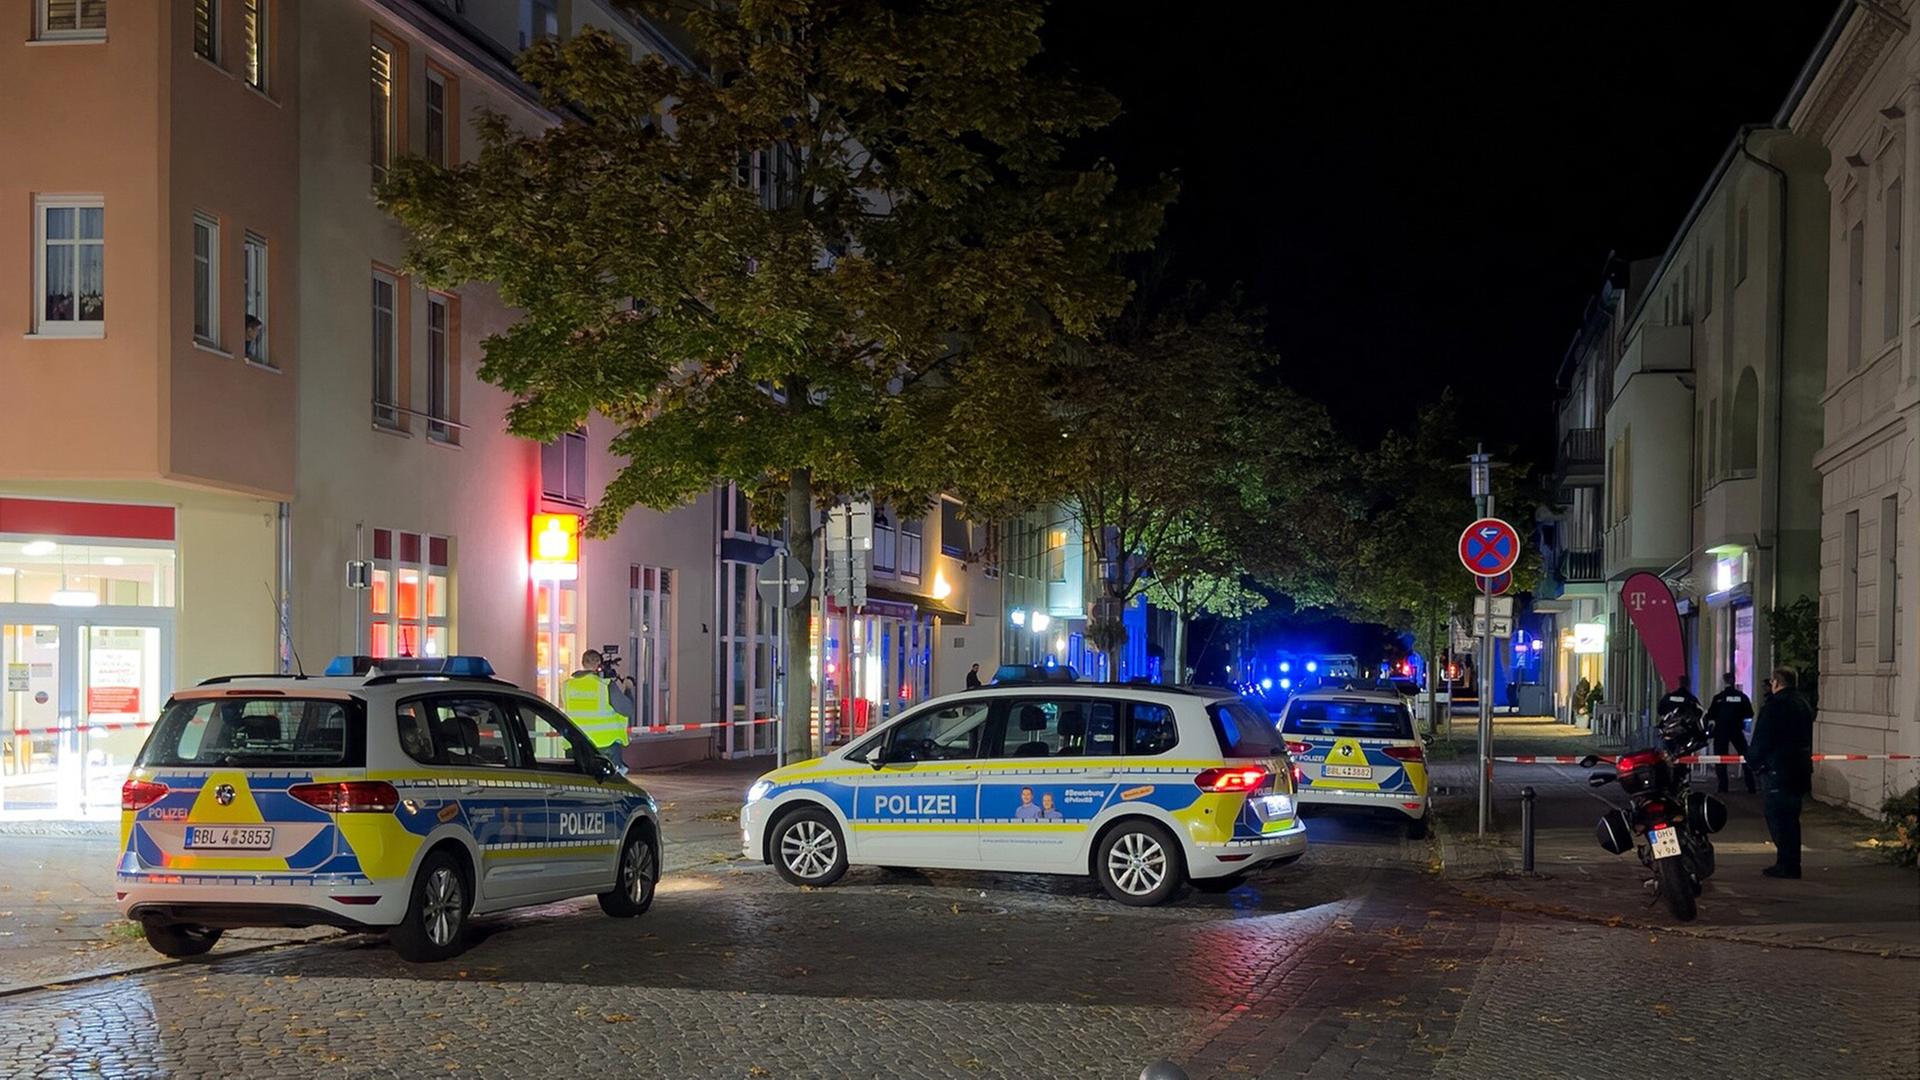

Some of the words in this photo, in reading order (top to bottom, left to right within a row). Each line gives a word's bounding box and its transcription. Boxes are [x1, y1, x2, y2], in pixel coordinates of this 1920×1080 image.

[148, 807, 189, 819] POLIZEI
[875, 795, 957, 814] POLIZEI
[559, 812, 606, 836] POLIZEI
[193, 829, 217, 845] BBL
[222, 830, 229, 844] 4
[239, 830, 271, 845] 3853
